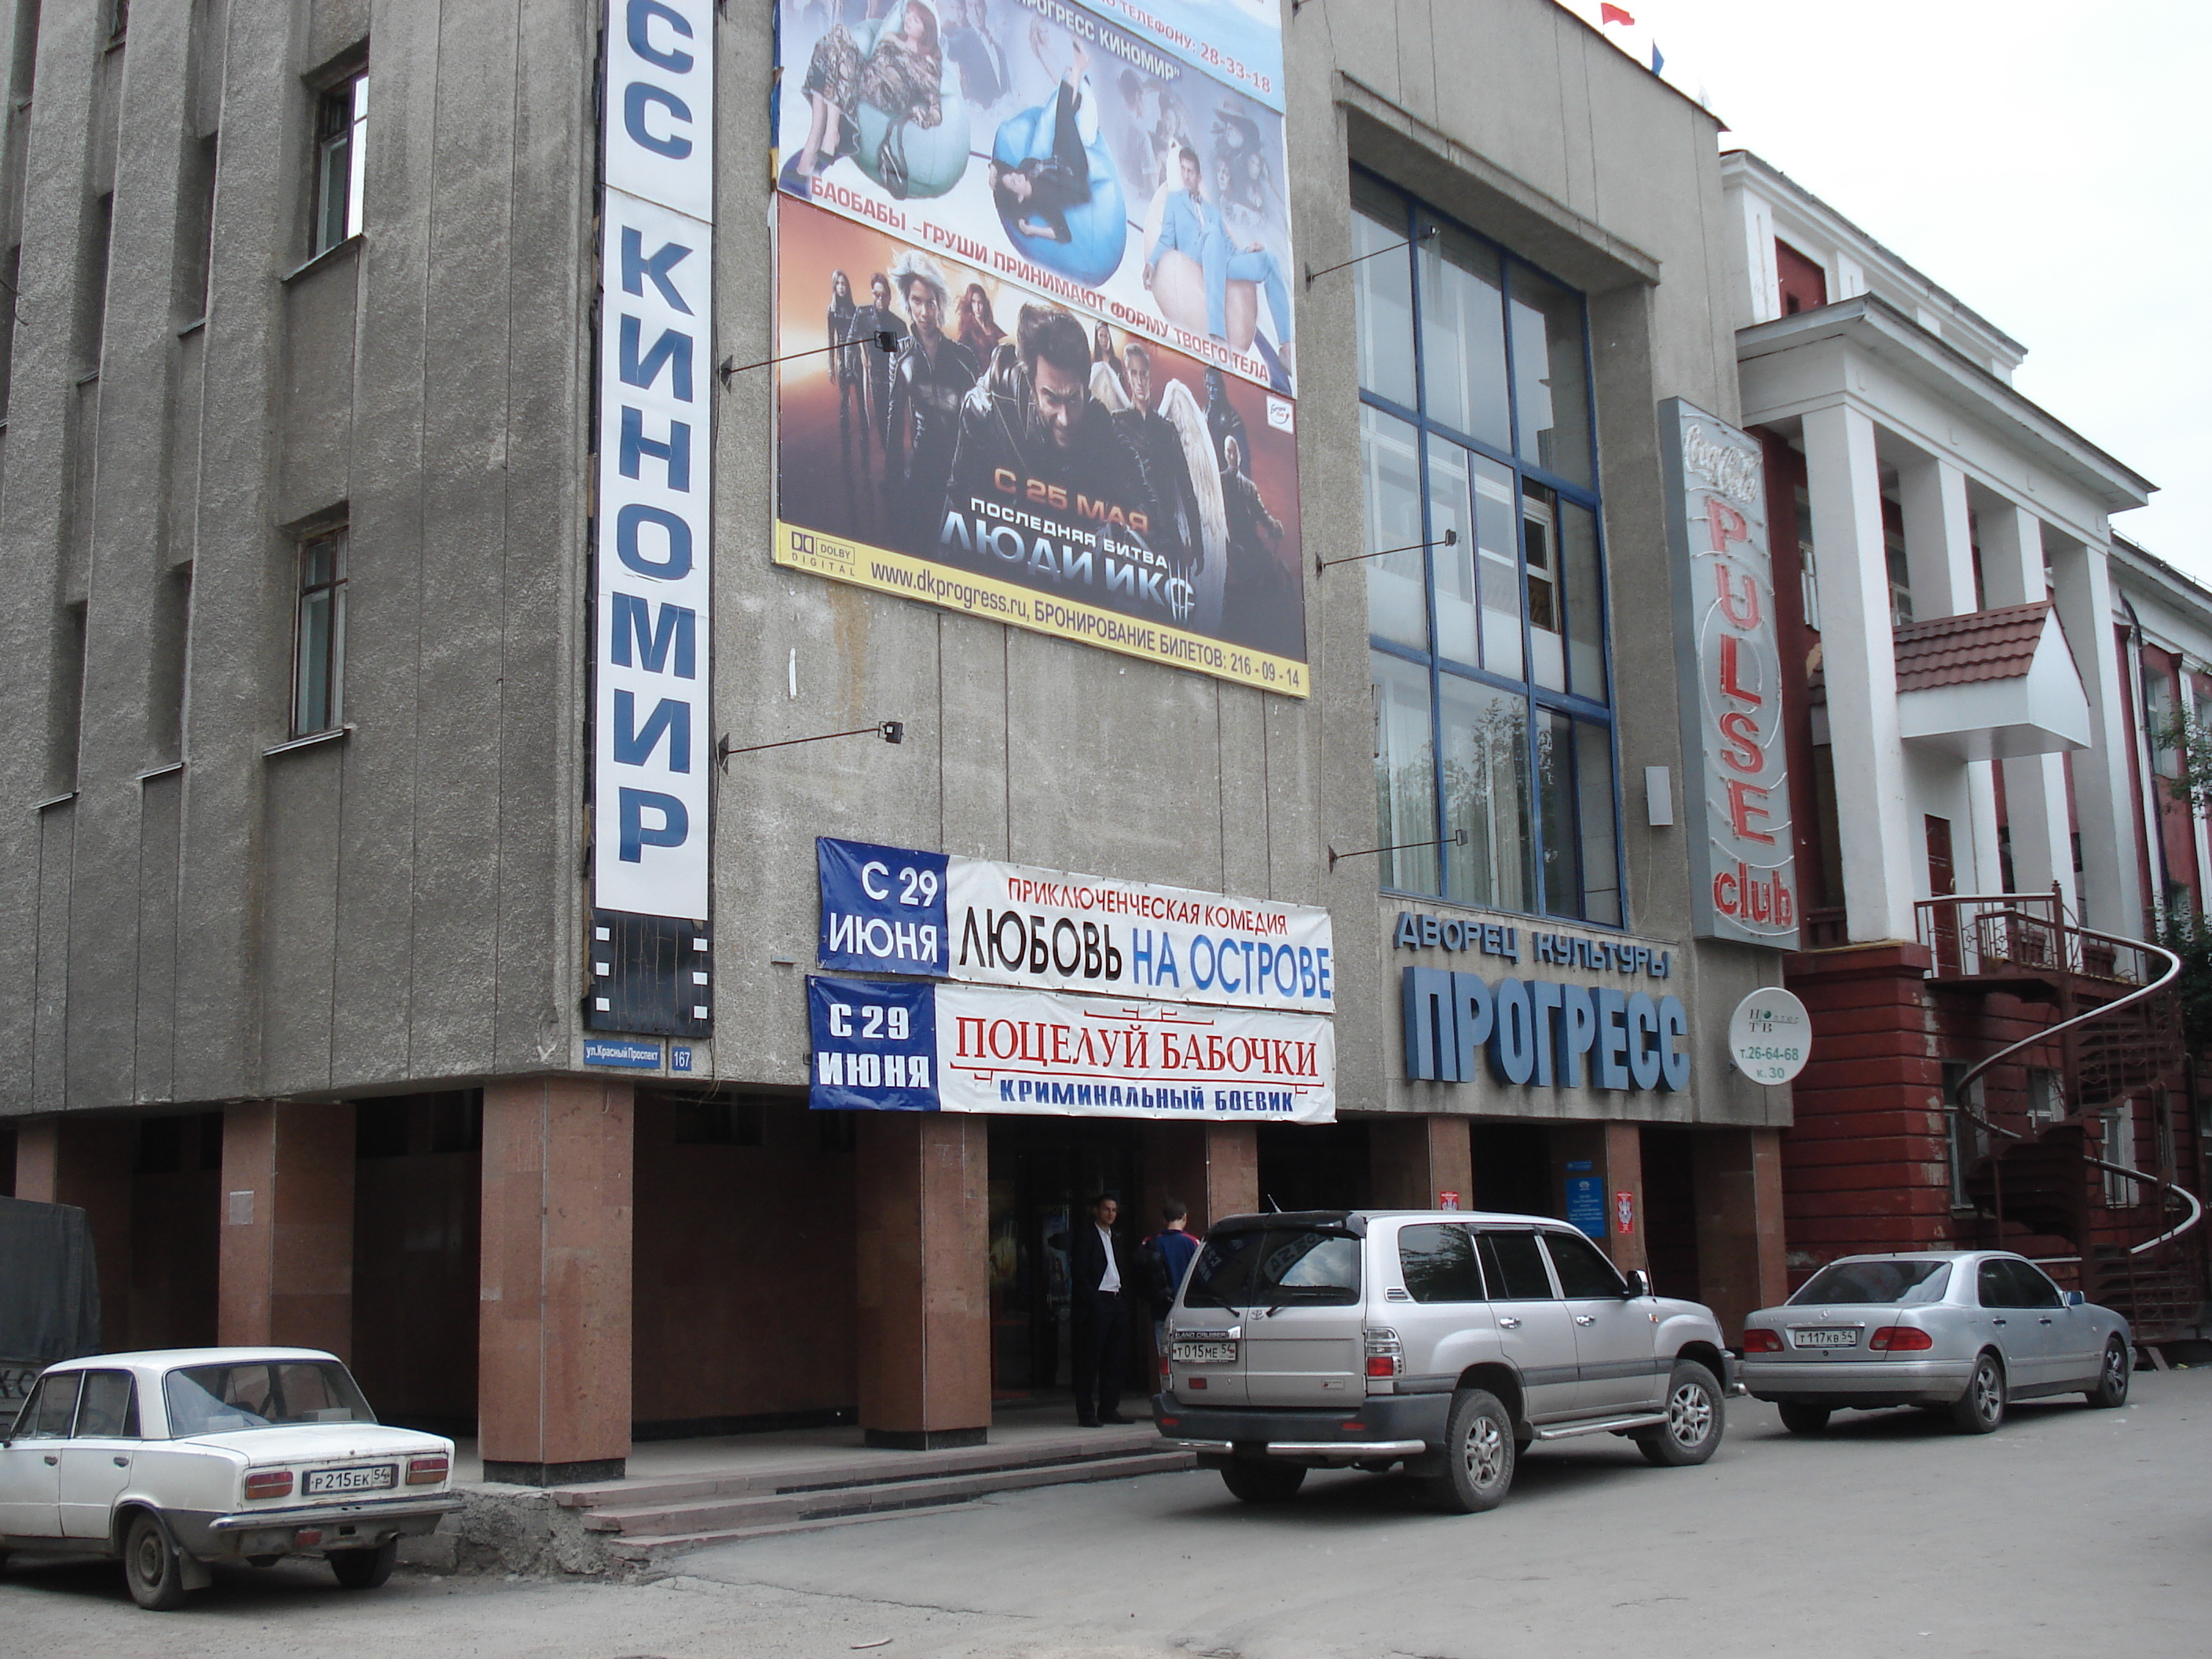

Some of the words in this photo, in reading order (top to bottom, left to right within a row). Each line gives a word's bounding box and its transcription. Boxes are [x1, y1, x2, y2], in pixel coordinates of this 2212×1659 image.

[1016, 0, 1095, 40] ОГРЕСС
[1119, 0, 1196, 53] ТЕЛЕФОНУ:
[1200, 42, 1271, 93] 28-33-18
[811, 175, 906, 231] БАОБАБЫ
[993, 250, 1106, 311] ПРИНИМАЮТ
[1111, 301, 1170, 338] ФОРМУ
[1174, 327, 1228, 364] ТВОЕГО
[1232, 352, 1269, 382] ТЕЛА
[994, 467, 1016, 494] С
[1026, 478, 1068, 510] 25
[1076, 493, 1149, 535] МАЯ
[611, 225, 696, 863] КИНОМИР
[820, 544, 851, 560] DOLBY
[941, 510, 1093, 585] ЛЮДИ
[971, 496, 1097, 548] ПОСЛЕДНЯЯ
[1104, 537, 1168, 569] БИТВА
[791, 551, 855, 577] DIGITAL
[870, 561, 1030, 622] www.dkprogress.ru,
[1035, 600, 1155, 651] БРОНИРОВАНИЕ
[1159, 633, 1227, 669] БИЛЕТОВ:
[1706, 496, 1775, 846] PULSE
[862, 861, 889, 901] С
[899, 866, 938, 907] 29
[1008, 877, 1201, 927] ПРИКЛЮЧЕНЧЕСКАЯ
[1204, 903, 1288, 938] КОМЕДИЯ
[1713, 862, 1793, 926] club
[830, 912, 938, 964] ИЮНЯ
[959, 906, 1122, 981] ЛЮБОВЬ
[1132, 928, 1179, 989] НА
[1190, 933, 1331, 1000] ОСТРОВЕ
[1393, 911, 1520, 965] ДВОРЕЦ
[1533, 931, 1672, 979] КУЛЬТУРЫ
[830, 1003, 854, 1038] С
[862, 1005, 909, 1040] 29
[955, 1016, 1148, 1069] ПОЦЕЛУЙ
[1160, 1031, 1320, 1077] БАБОЧКИ
[1403, 966, 1690, 1093] ПРОГРЕСС
[628, 1046, 658, 1061] Проспект
[674, 1050, 690, 1068] 167
[818, 1053, 930, 1089] ИЮНЯ
[999, 1079, 1203, 1112] КРИМИНАЛЬНЫЙ
[1214, 1090, 1295, 1112] БОЕВИК
[374, 1468, 386, 1480] 54
